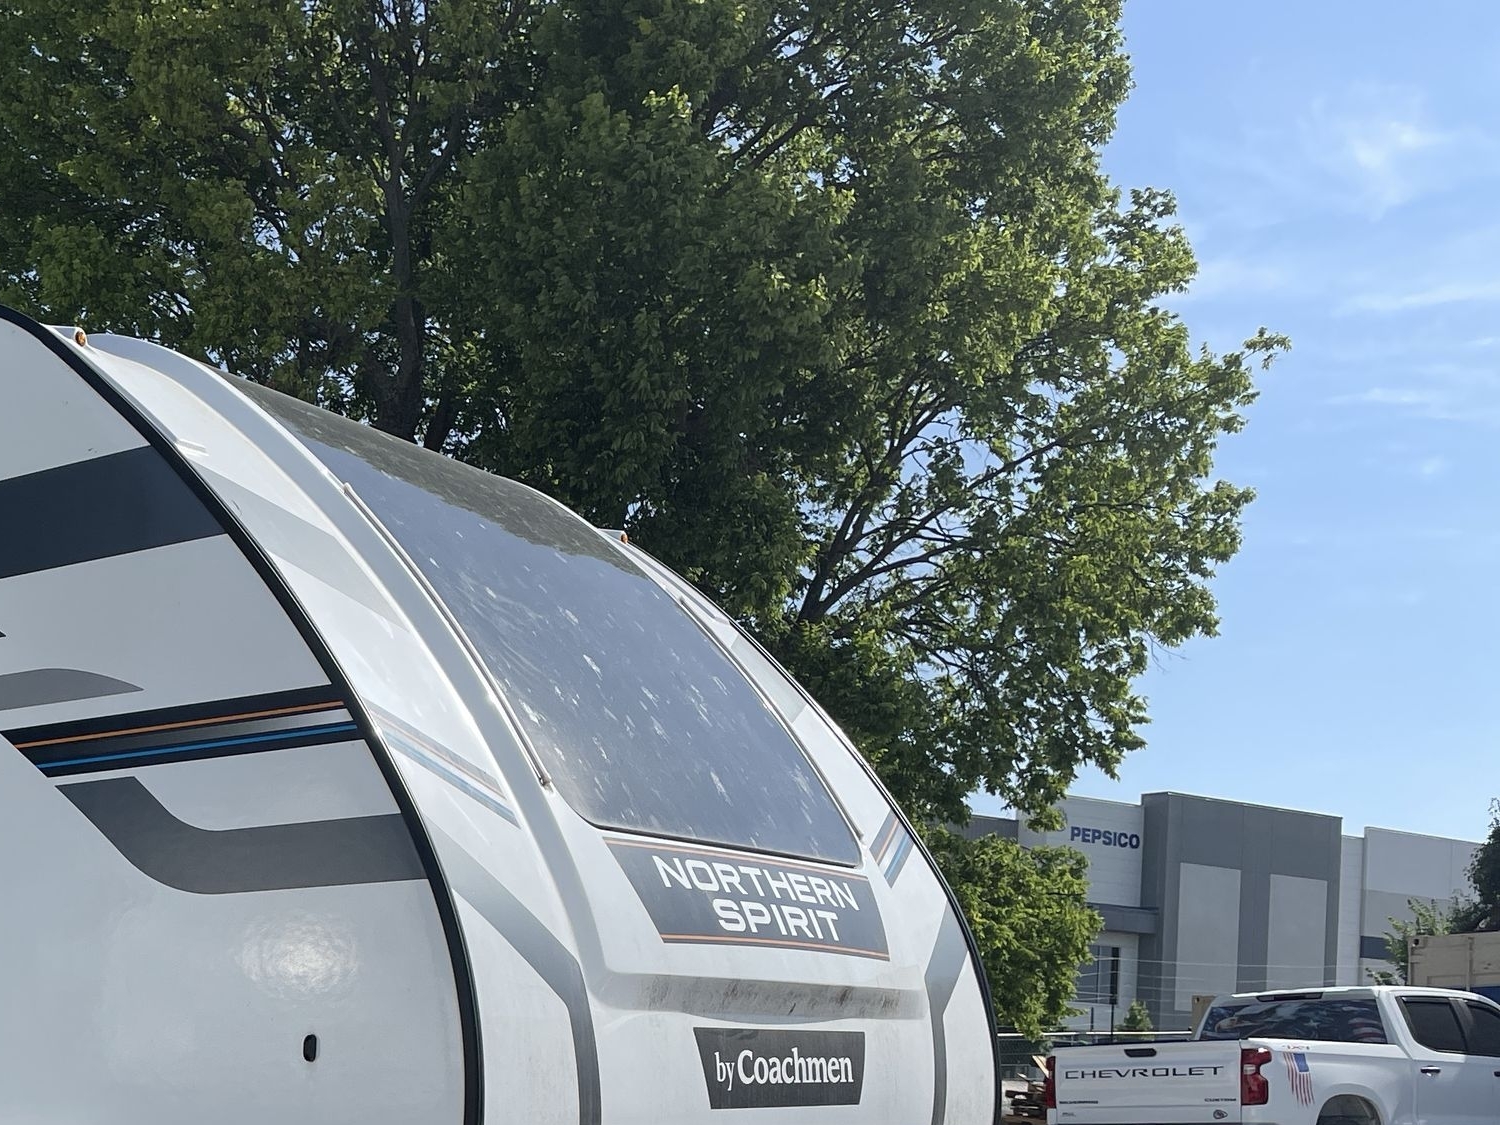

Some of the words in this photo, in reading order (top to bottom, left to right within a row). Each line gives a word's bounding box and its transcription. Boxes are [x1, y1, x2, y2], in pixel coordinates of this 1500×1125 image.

[1070, 826, 1140, 849] PEPSICO
[651, 855, 860, 911] NORTHERN
[712, 898, 840, 942] SPIRIT
[714, 1051, 735, 1091] by
[736, 1047, 854, 1085] Coachmen
[1064, 1065, 1224, 1079] CHEVROLET
